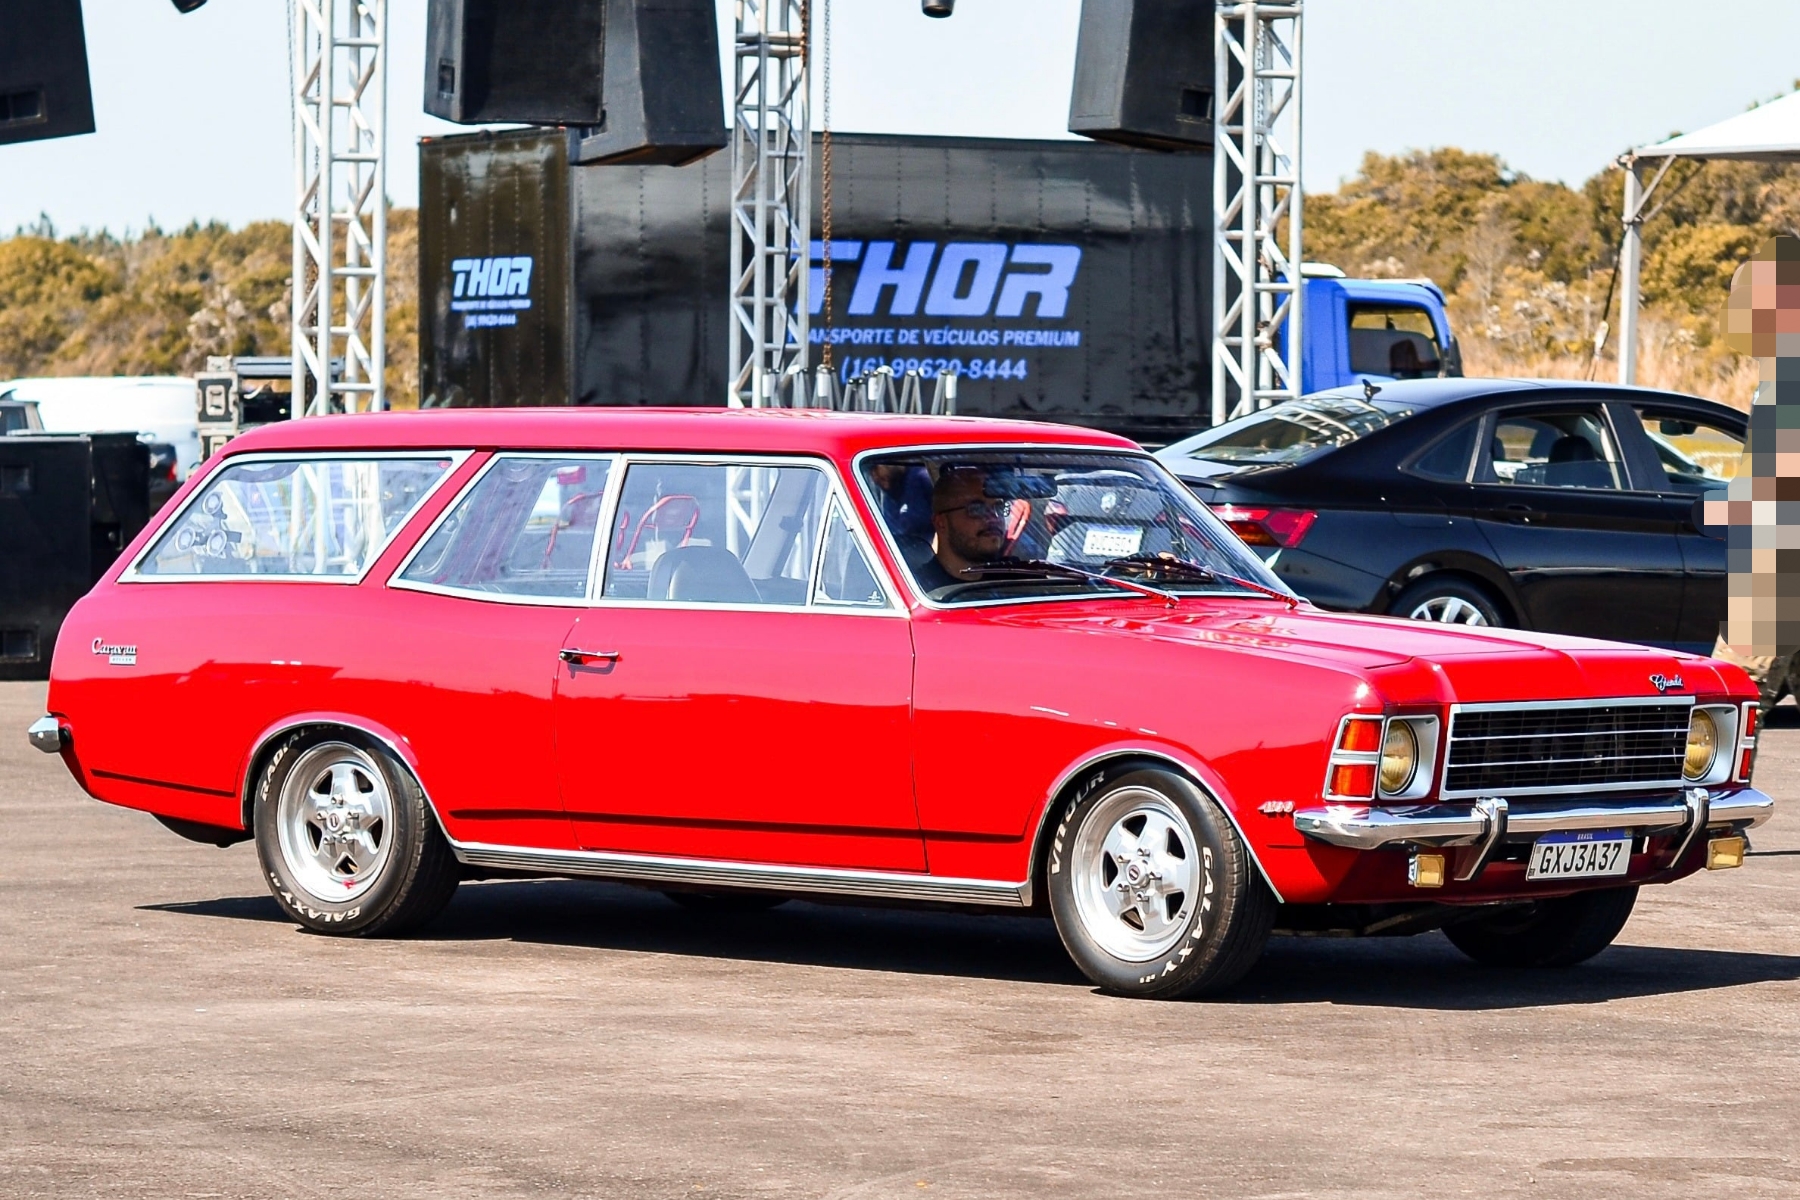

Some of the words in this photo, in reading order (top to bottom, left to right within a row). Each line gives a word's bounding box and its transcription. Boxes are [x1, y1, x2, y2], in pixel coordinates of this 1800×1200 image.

[452, 256, 533, 298] THOR
[790, 240, 1082, 318] THOR
[898, 329, 919, 345] DE
[923, 325, 999, 346] VEÍCULOS
[1003, 330, 1080, 347] PREMIUM
[891, 358, 1028, 380] 99620-8444
[1539, 842, 1623, 874] GXJ3A37
[280, 890, 361, 923] GALAXY
[1162, 846, 1214, 977] GALAXY
